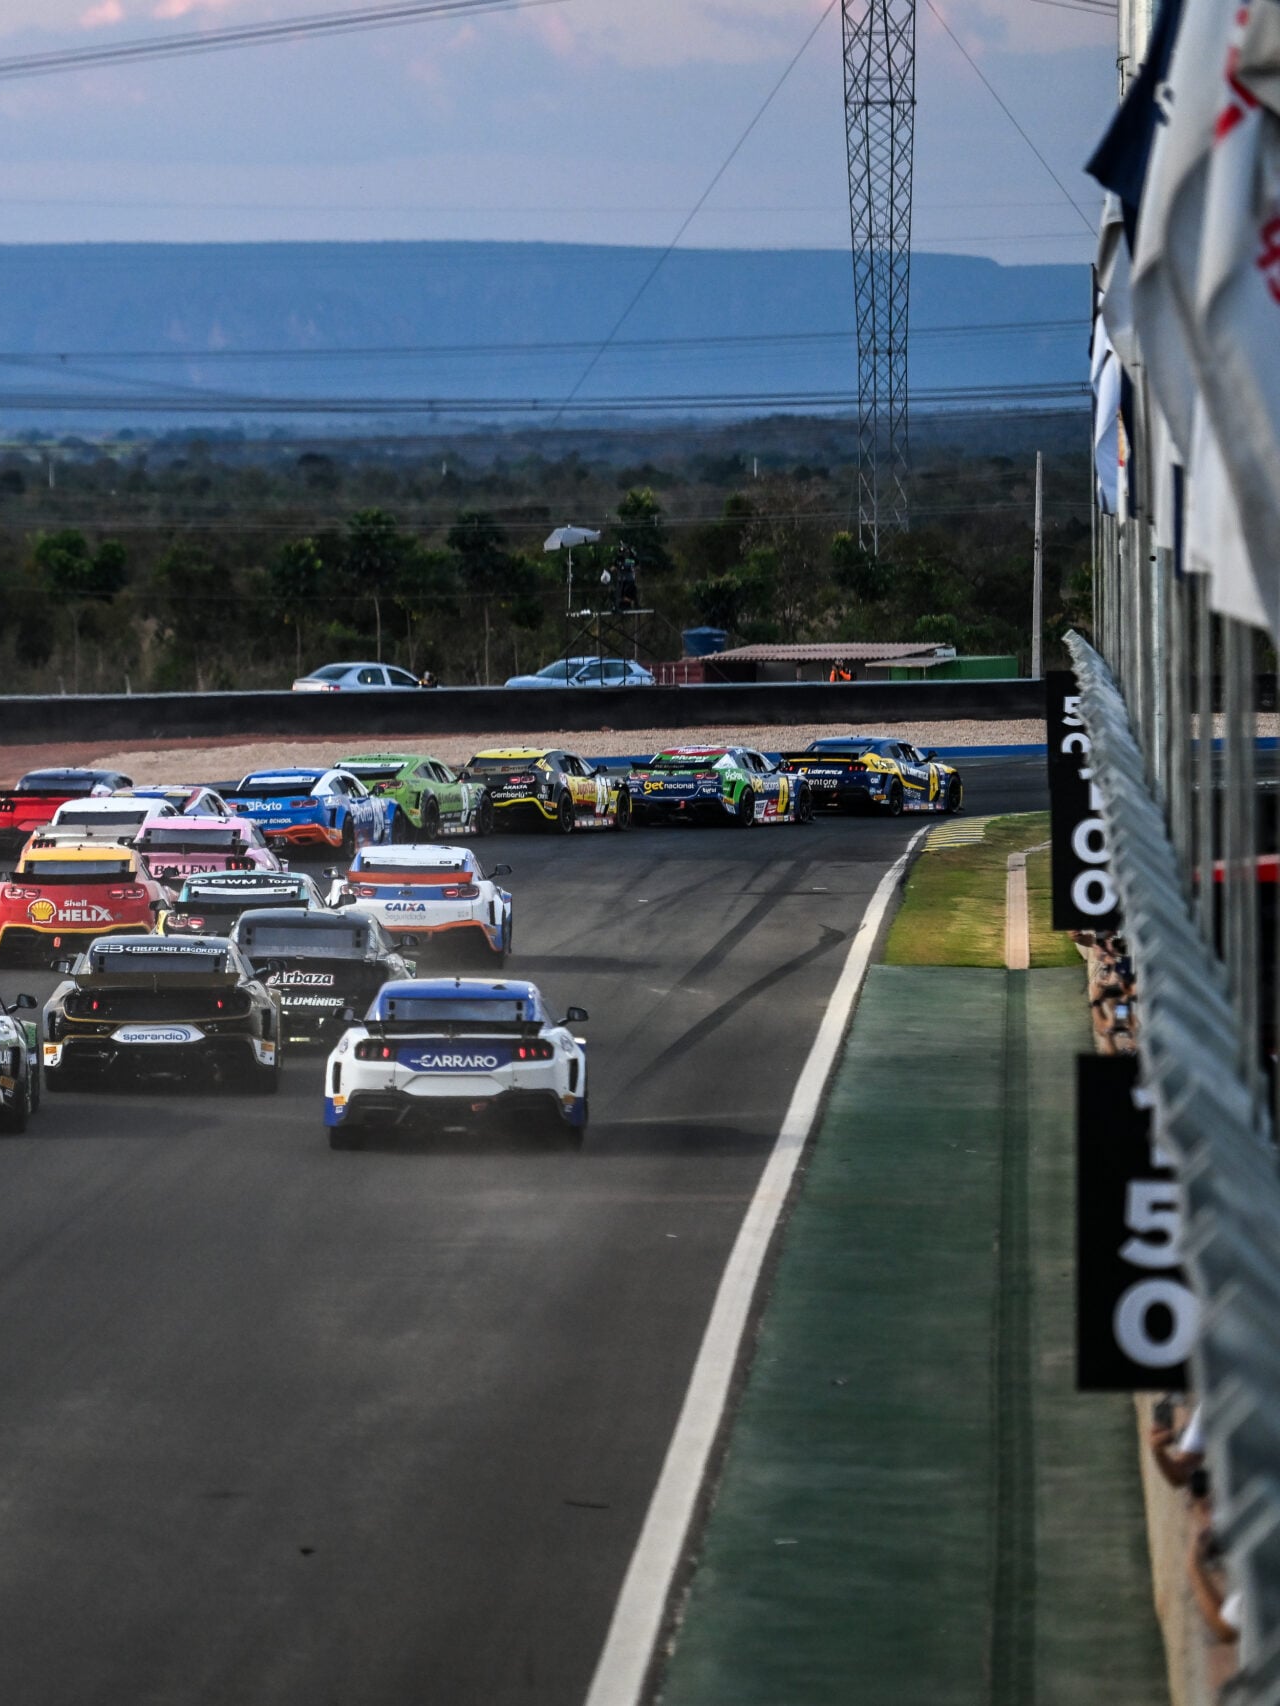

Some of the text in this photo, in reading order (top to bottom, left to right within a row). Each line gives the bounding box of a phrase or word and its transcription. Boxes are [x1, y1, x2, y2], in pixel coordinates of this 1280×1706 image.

[255, 801, 282, 811] Porto
[154, 864, 218, 875] BLENA
[64, 899, 88, 907] Shell
[384, 903, 426, 912] CAIXA
[58, 905, 114, 922] HELIX
[265, 970, 334, 986] Arbaza
[123, 1032, 183, 1041] sperandio
[420, 1055, 498, 1067] CARRARO
